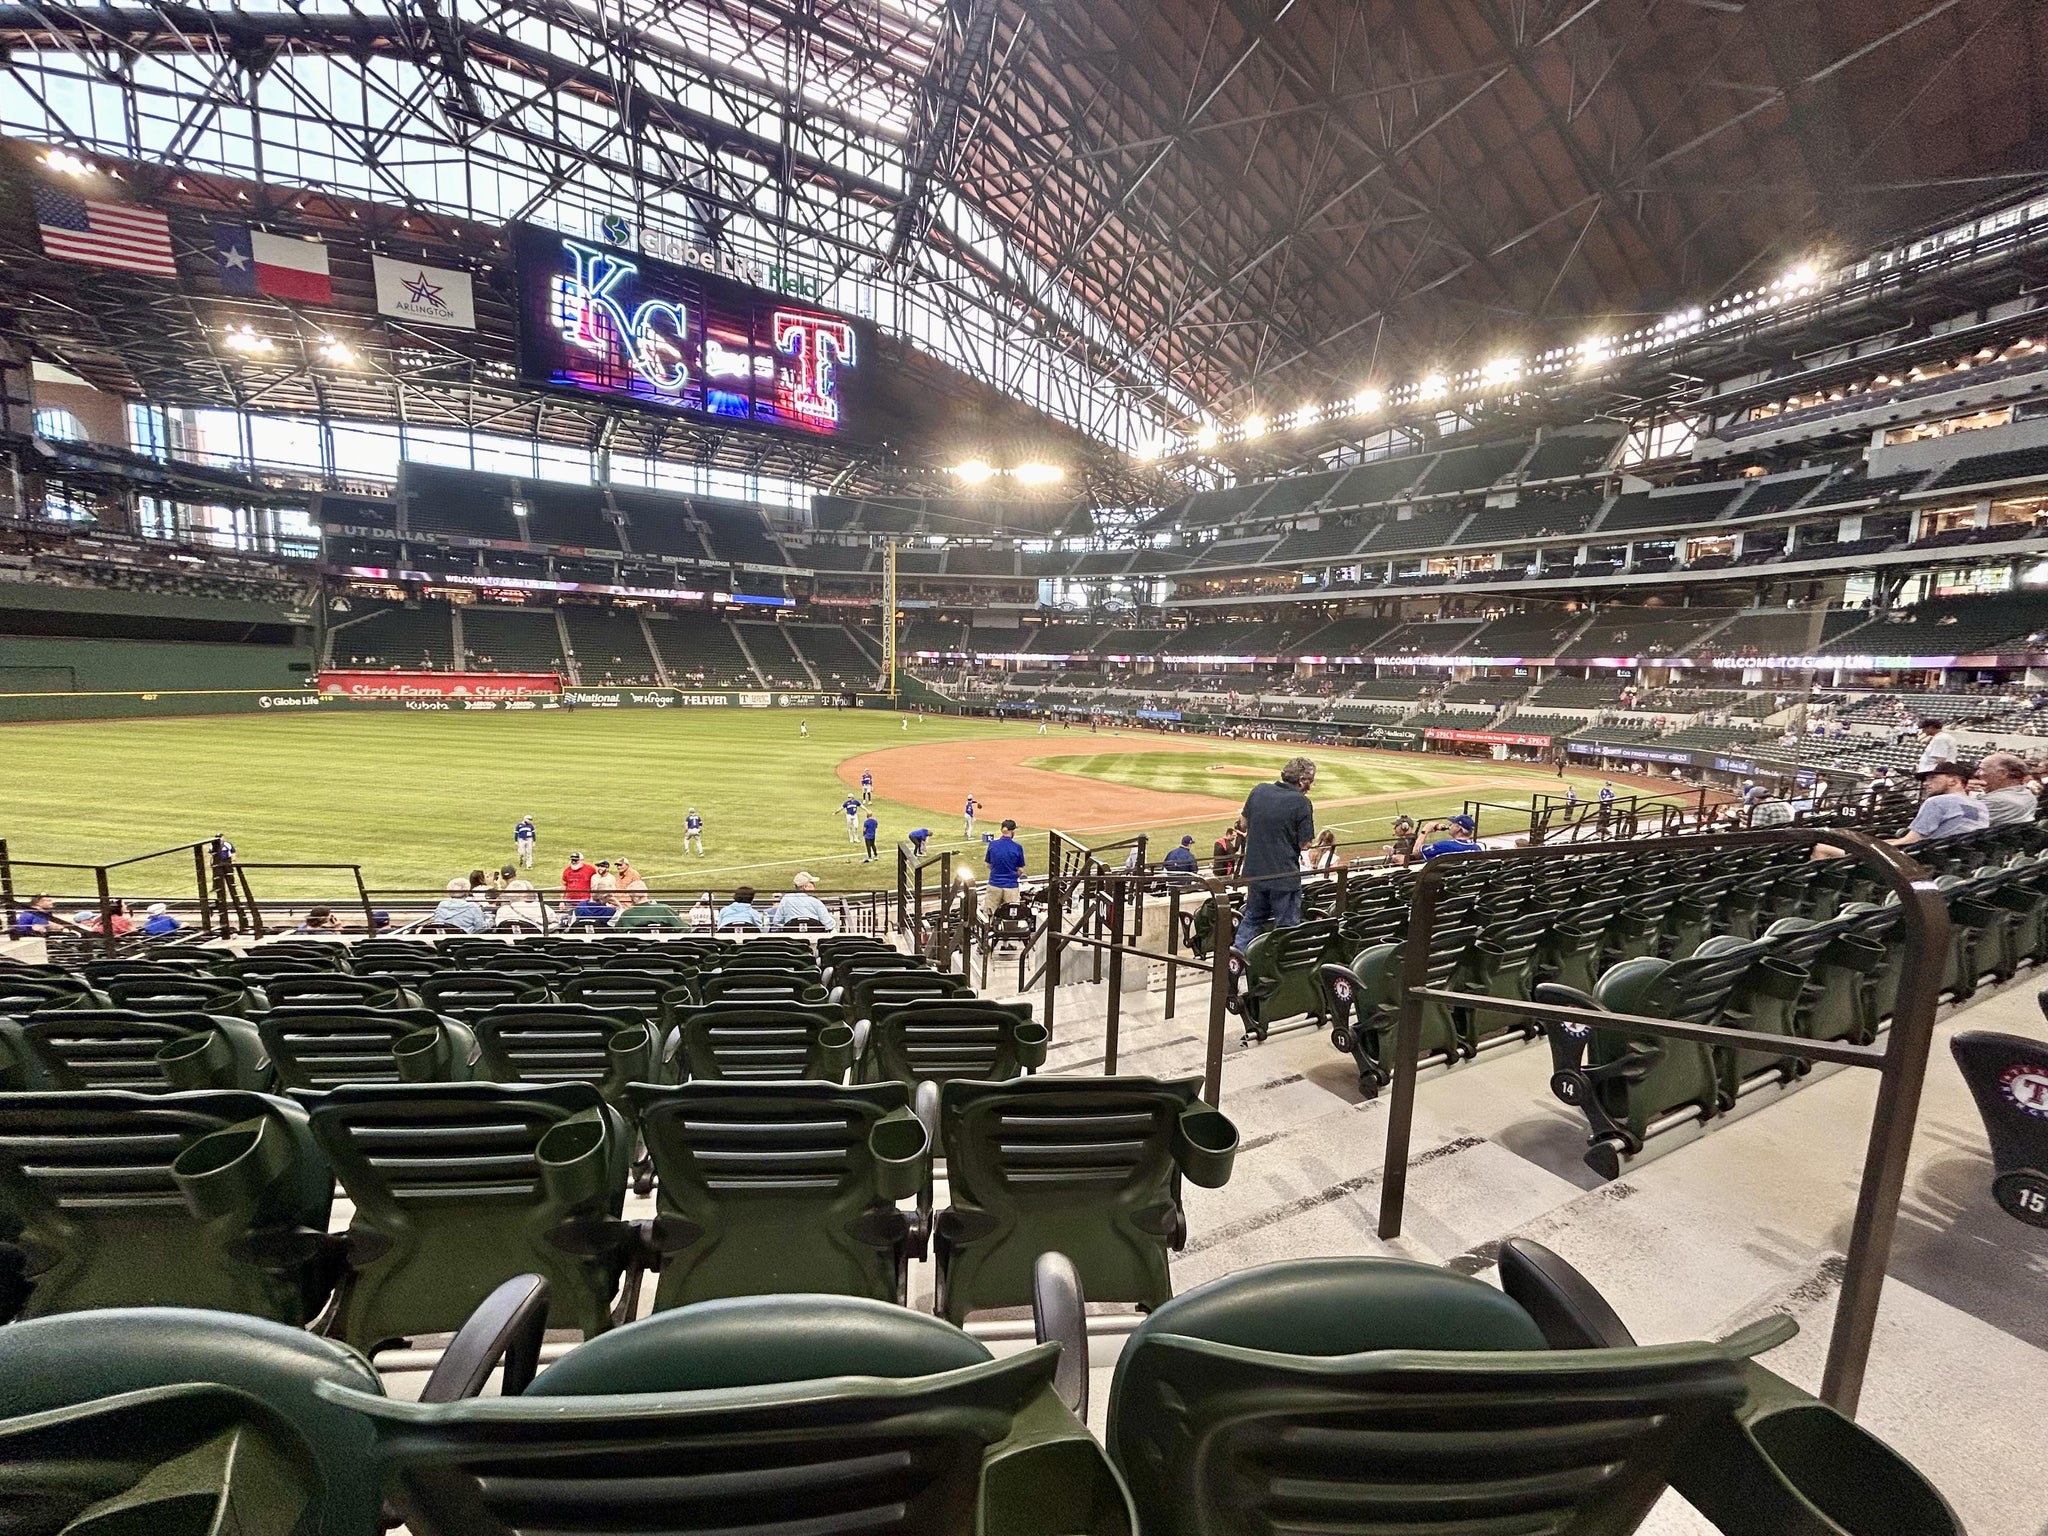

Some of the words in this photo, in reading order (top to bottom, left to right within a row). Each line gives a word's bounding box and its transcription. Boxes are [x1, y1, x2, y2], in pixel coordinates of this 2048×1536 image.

[639, 228, 716, 270] Globe
[720, 251, 763, 283] Life
[769, 264, 817, 299] Field
[395, 301, 454, 319] ARLINGTON
[343, 525, 368, 537] UT
[372, 527, 436, 543] DALLAS
[467, 538, 491, 547] 105.3
[445, 575, 485, 584] WELCOME
[1374, 656, 1413, 665] WELCOME
[1712, 657, 1774, 668] WELCOME
[1780, 658, 1795, 668] TO
[272, 697, 302, 706] Globe
[302, 696, 319, 705] Life
[576, 693, 619, 703] National
[644, 691, 674, 707] Kroger
[405, 701, 450, 710] Kubota
[1384, 730, 1403, 738] Medical
[1404, 731, 1416, 739] City
[1337, 1034, 1345, 1047] 13
[1561, 1081, 1575, 1097] 14
[2018, 1187, 2047, 1213] 15
